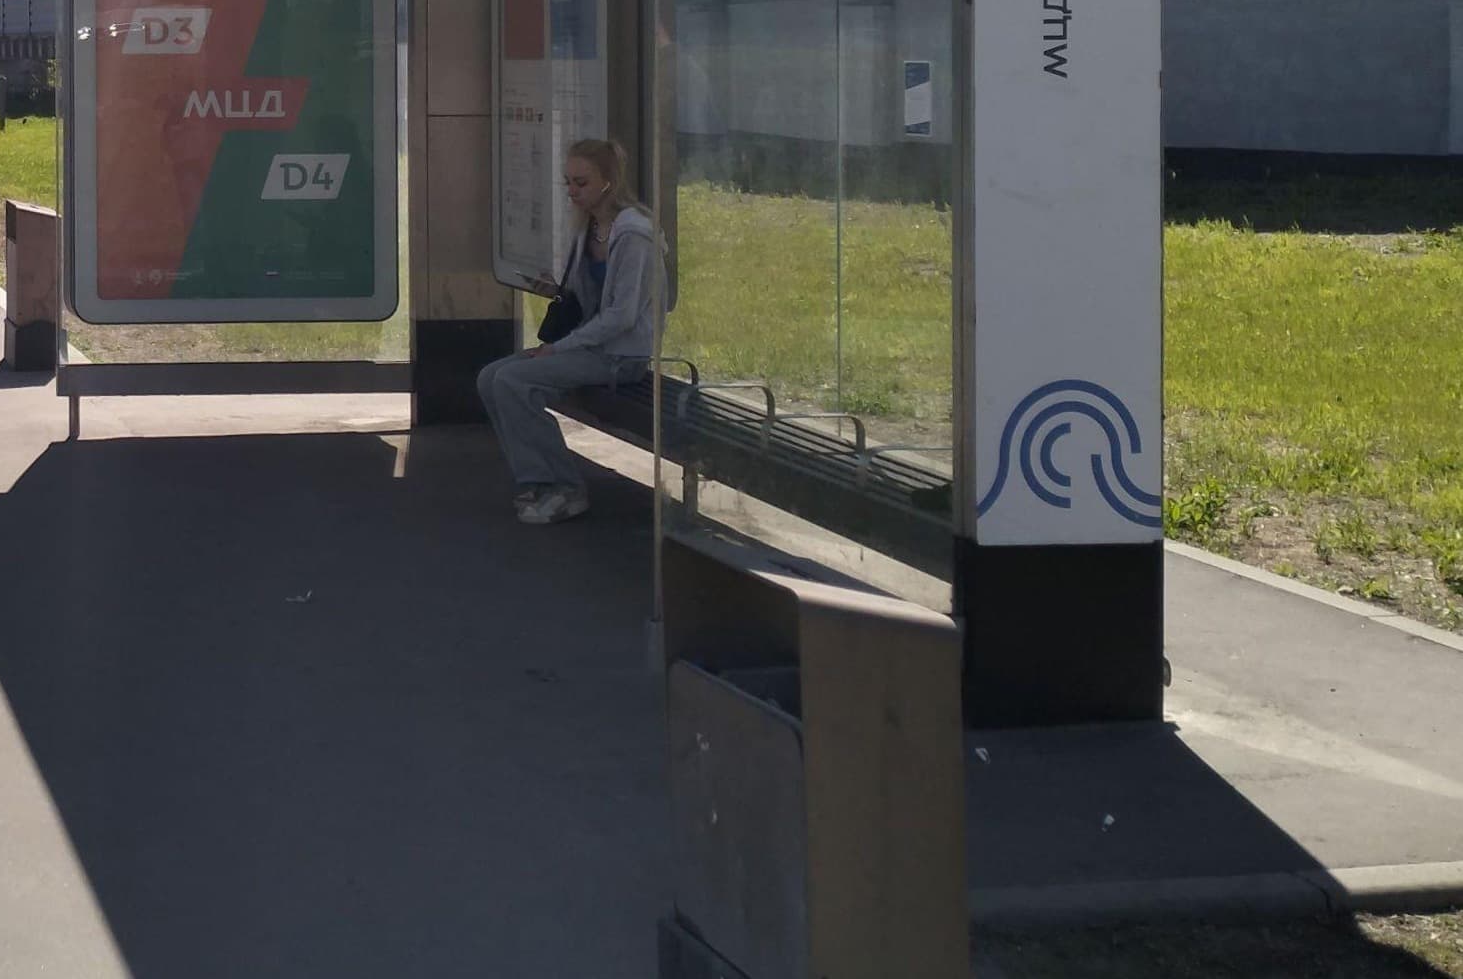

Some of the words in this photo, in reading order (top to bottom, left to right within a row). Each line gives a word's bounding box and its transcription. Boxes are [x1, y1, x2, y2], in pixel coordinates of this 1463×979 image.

[141, 17, 195, 45] D3
[184, 90, 286, 118] МЦД
[279, 162, 334, 191] D4
